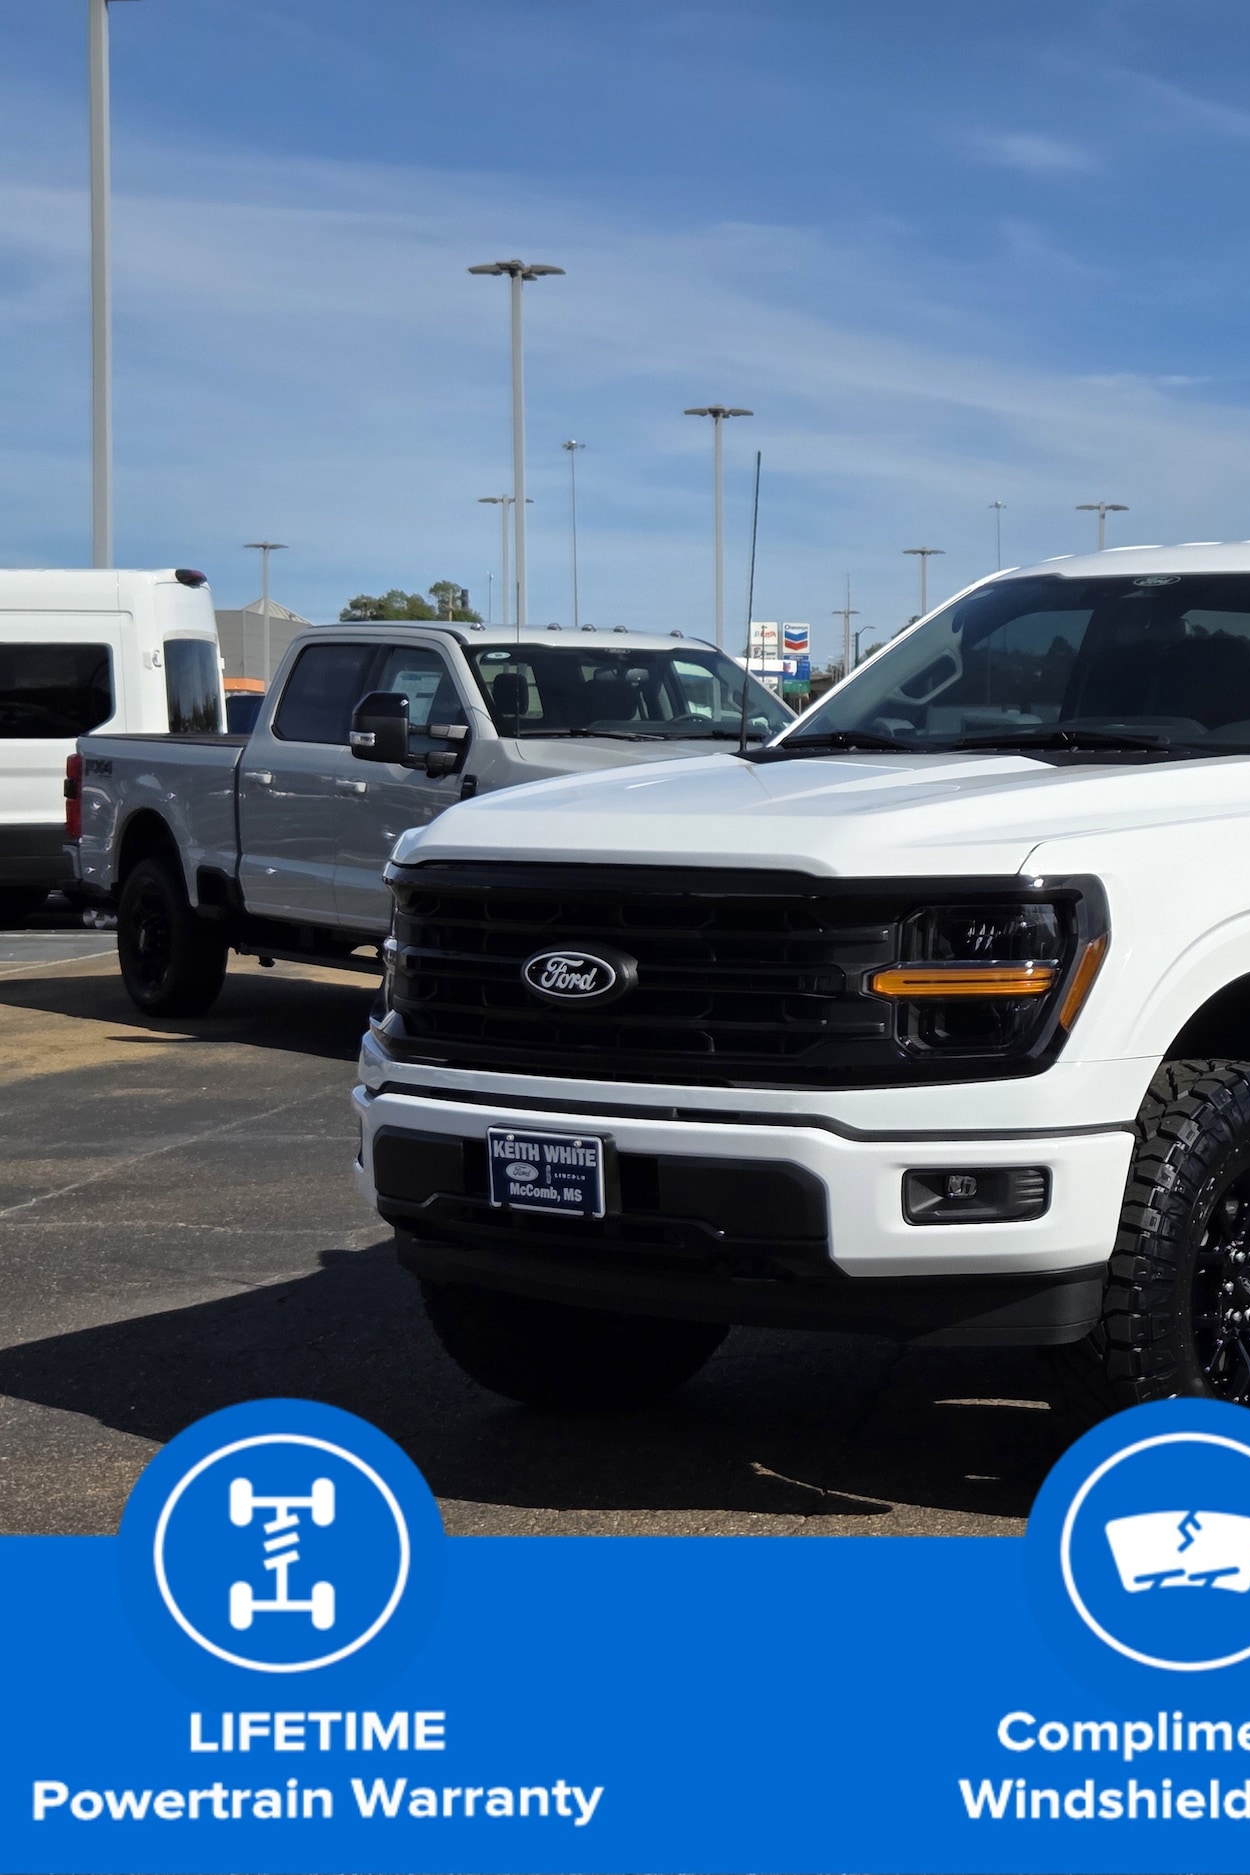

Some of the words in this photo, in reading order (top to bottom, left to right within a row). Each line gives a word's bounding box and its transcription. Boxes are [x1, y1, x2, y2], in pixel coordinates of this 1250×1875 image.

[541, 957, 597, 991] Ford
[493, 1139, 540, 1162] KEITH
[543, 1144, 597, 1168] WHITE
[511, 1165, 532, 1178] Ford
[509, 1181, 561, 1203] McComb,
[563, 1187, 583, 1203] MS
